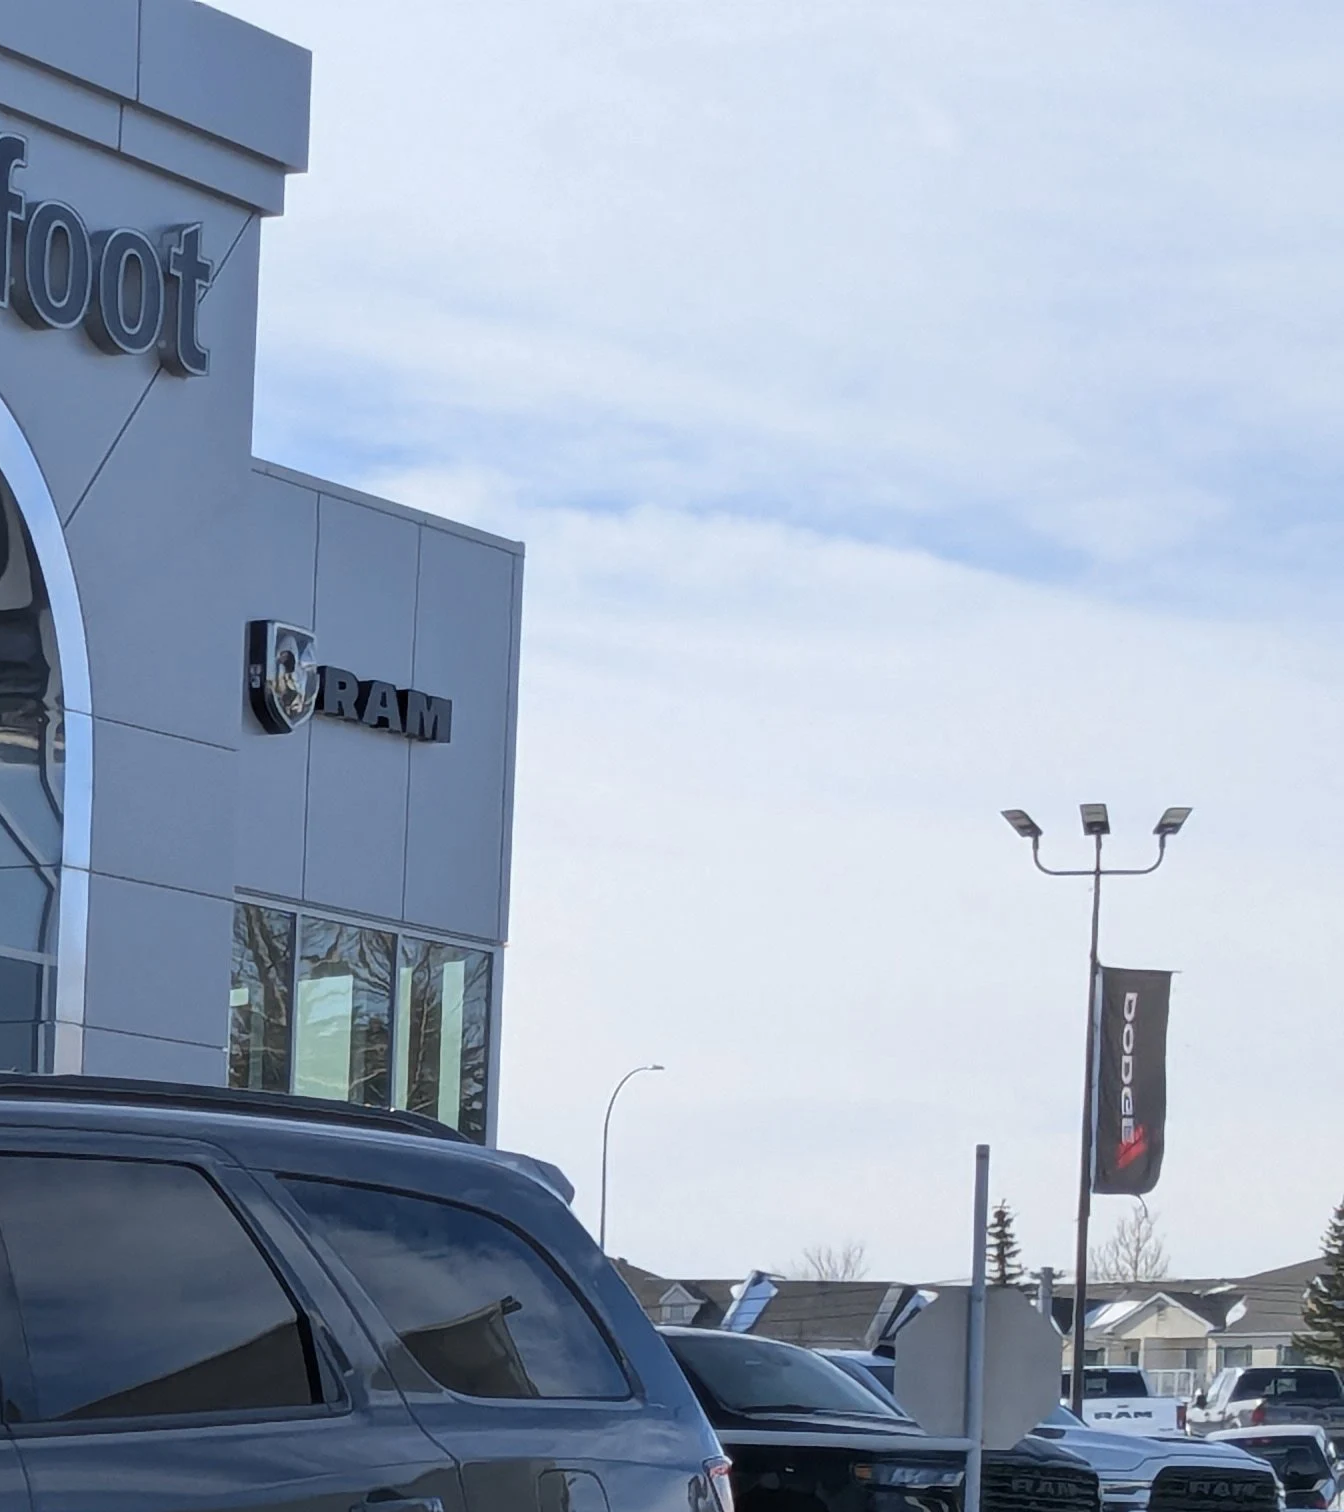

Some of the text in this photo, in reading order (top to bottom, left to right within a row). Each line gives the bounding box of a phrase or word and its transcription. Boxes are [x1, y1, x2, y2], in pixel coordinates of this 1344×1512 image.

[315, 665, 452, 743] RAM
[1121, 992, 1138, 1145] DODGE
[1094, 1411, 1152, 1420] RAM
[1012, 1479, 1078, 1497] RAM
[1189, 1481, 1257, 1497] RAM
